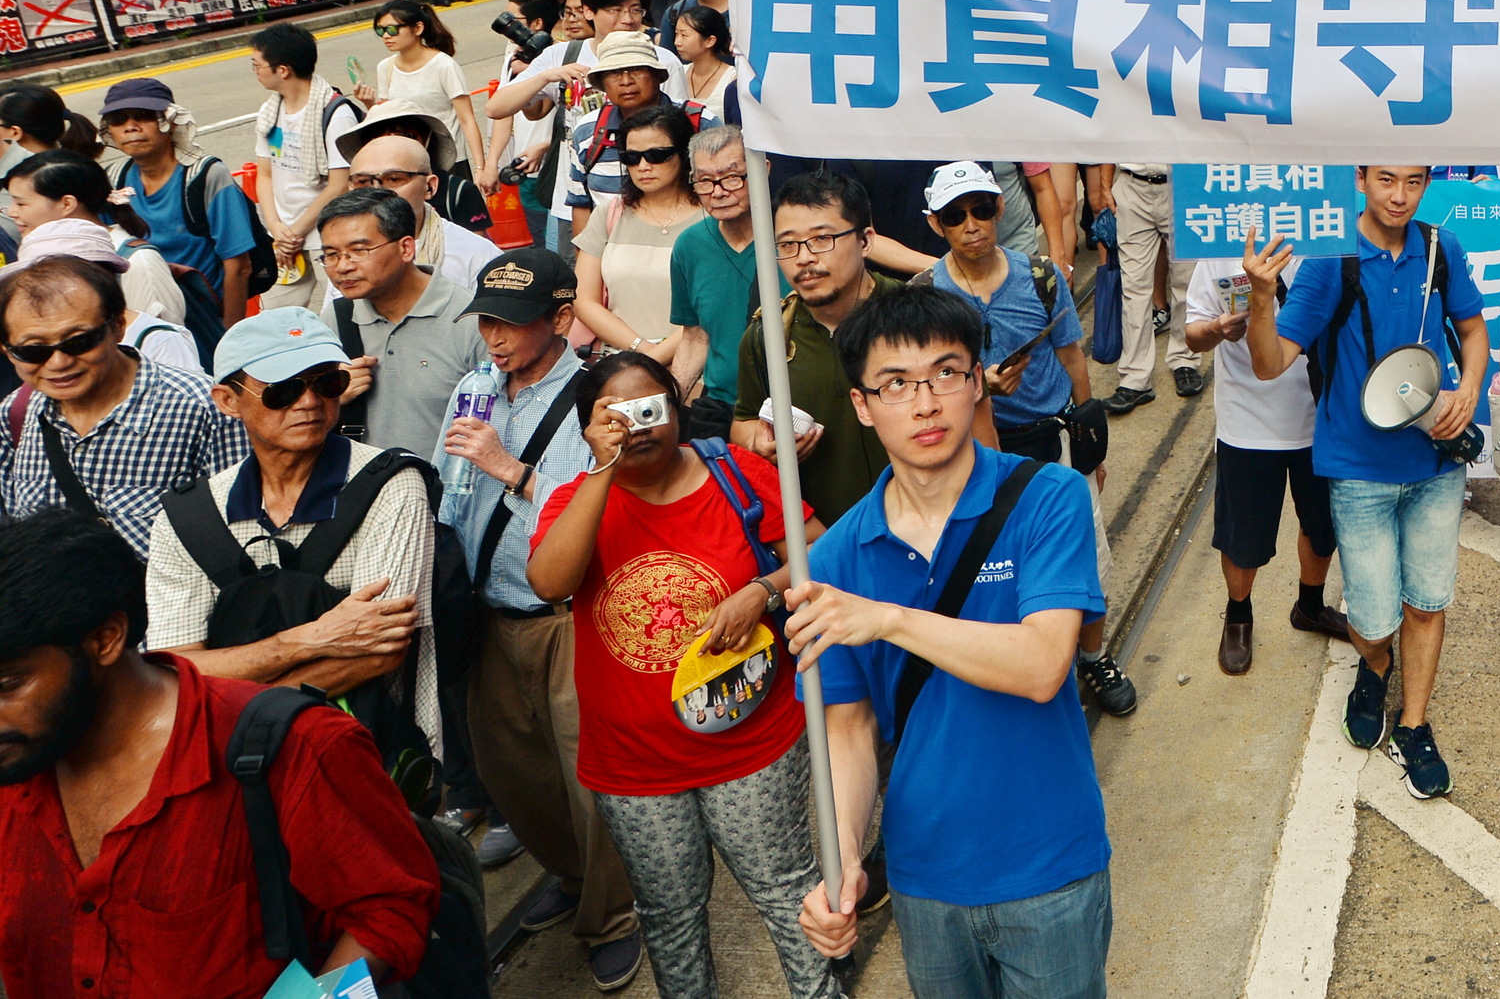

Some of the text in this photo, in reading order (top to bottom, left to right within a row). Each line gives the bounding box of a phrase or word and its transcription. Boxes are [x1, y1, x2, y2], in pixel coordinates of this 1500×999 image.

[1184, 199, 1346, 243] 守護自由
[621, 654, 647, 671] HONG
